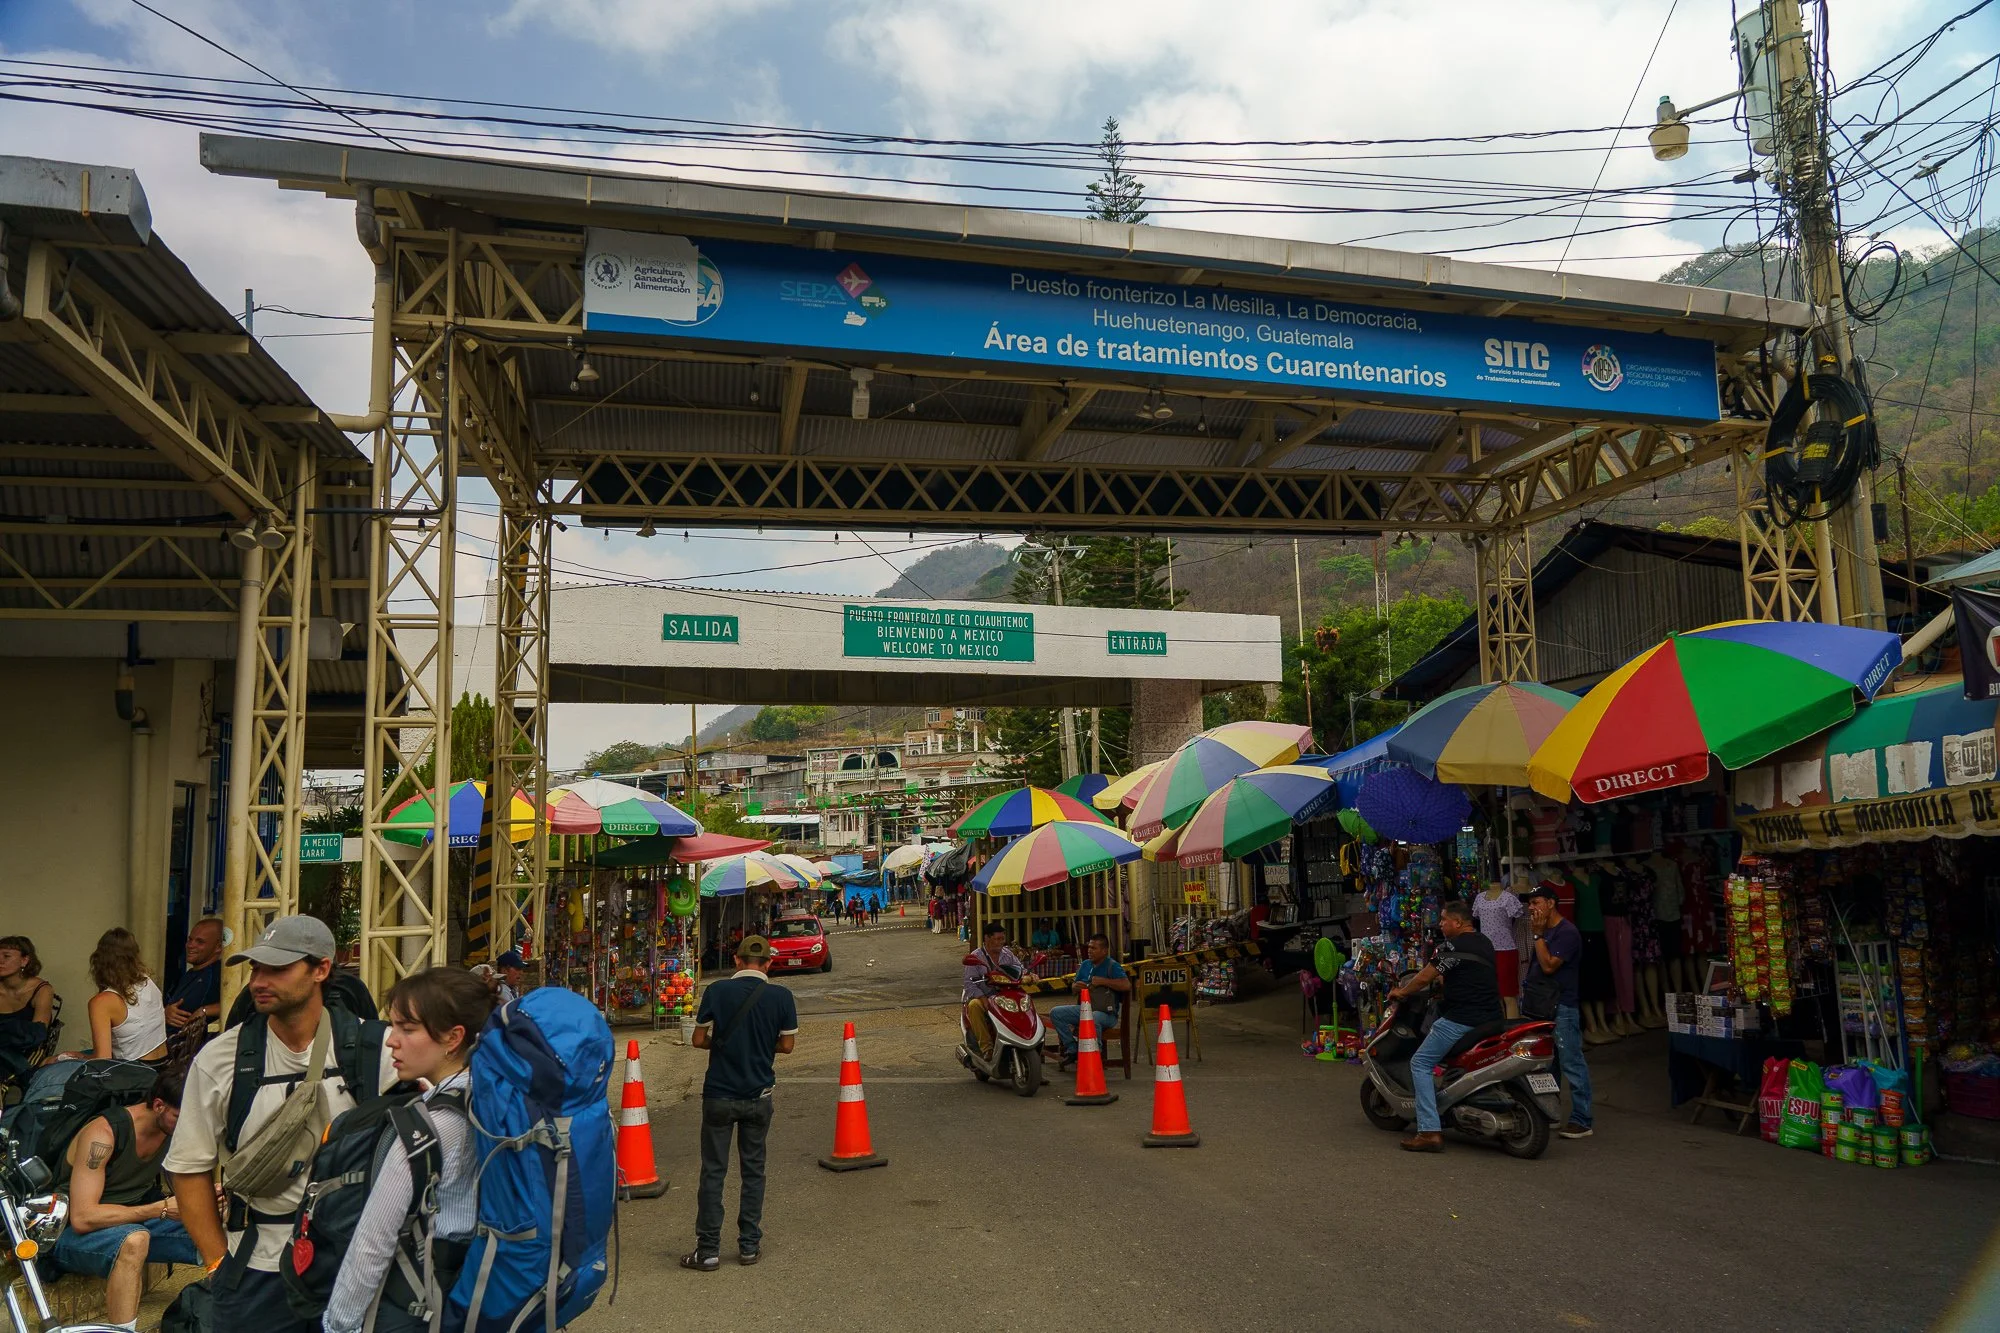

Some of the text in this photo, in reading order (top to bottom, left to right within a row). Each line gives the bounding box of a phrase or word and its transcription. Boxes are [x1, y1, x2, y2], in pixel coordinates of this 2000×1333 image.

[634, 257, 675, 268] Ministerio
[634, 266, 686, 277] Agricultura,
[634, 274, 686, 287] Ganadería y
[780, 280, 845, 301] SEPA
[1010, 273, 1423, 333] Puesto fronterizo La Mesilla, La Democracia,
[1093, 308, 1354, 350] Huehuetenango, Guatemala
[983, 321, 1447, 388] Área de tratamientos Cuarentenarios
[1484, 338, 1550, 371] SITC
[1512, 370, 1547, 378] Internacional
[1626, 364, 1702, 377] ORGANISMO INTERNACIONAL
[1626, 371, 1654, 380] REGIONAL
[1485, 375, 1520, 384] Tratamientos
[1520, 378, 1560, 387] Cuarentenarios
[1626, 379, 1670, 388] AGROPECUARIA
[944, 613, 956, 625] DE
[959, 614, 971, 626] CD
[974, 615, 1029, 628] CUAUHTEMOC
[668, 620, 733, 638] SALIDA
[877, 626, 1004, 642] BIENVENIDO A MEXICO
[882, 641, 999, 657] WELCOME TO MEXICO
[1111, 635, 1163, 651] ENTRADA
[1863, 651, 1891, 692] DIRECT
[1595, 764, 1678, 793] DIRECT
[1299, 790, 1330, 819] DIRECT
[1819, 808, 1844, 837] LA
[1852, 793, 1957, 832] MARAVILLA
[1968, 787, 1998, 822] DE
[609, 823, 651, 831] DIRECT
[1134, 823, 1163, 839] DIRECT
[303, 838, 309, 847] A
[1184, 852, 1220, 866] DIRECT
[1075, 861, 1110, 875] DIRECT
